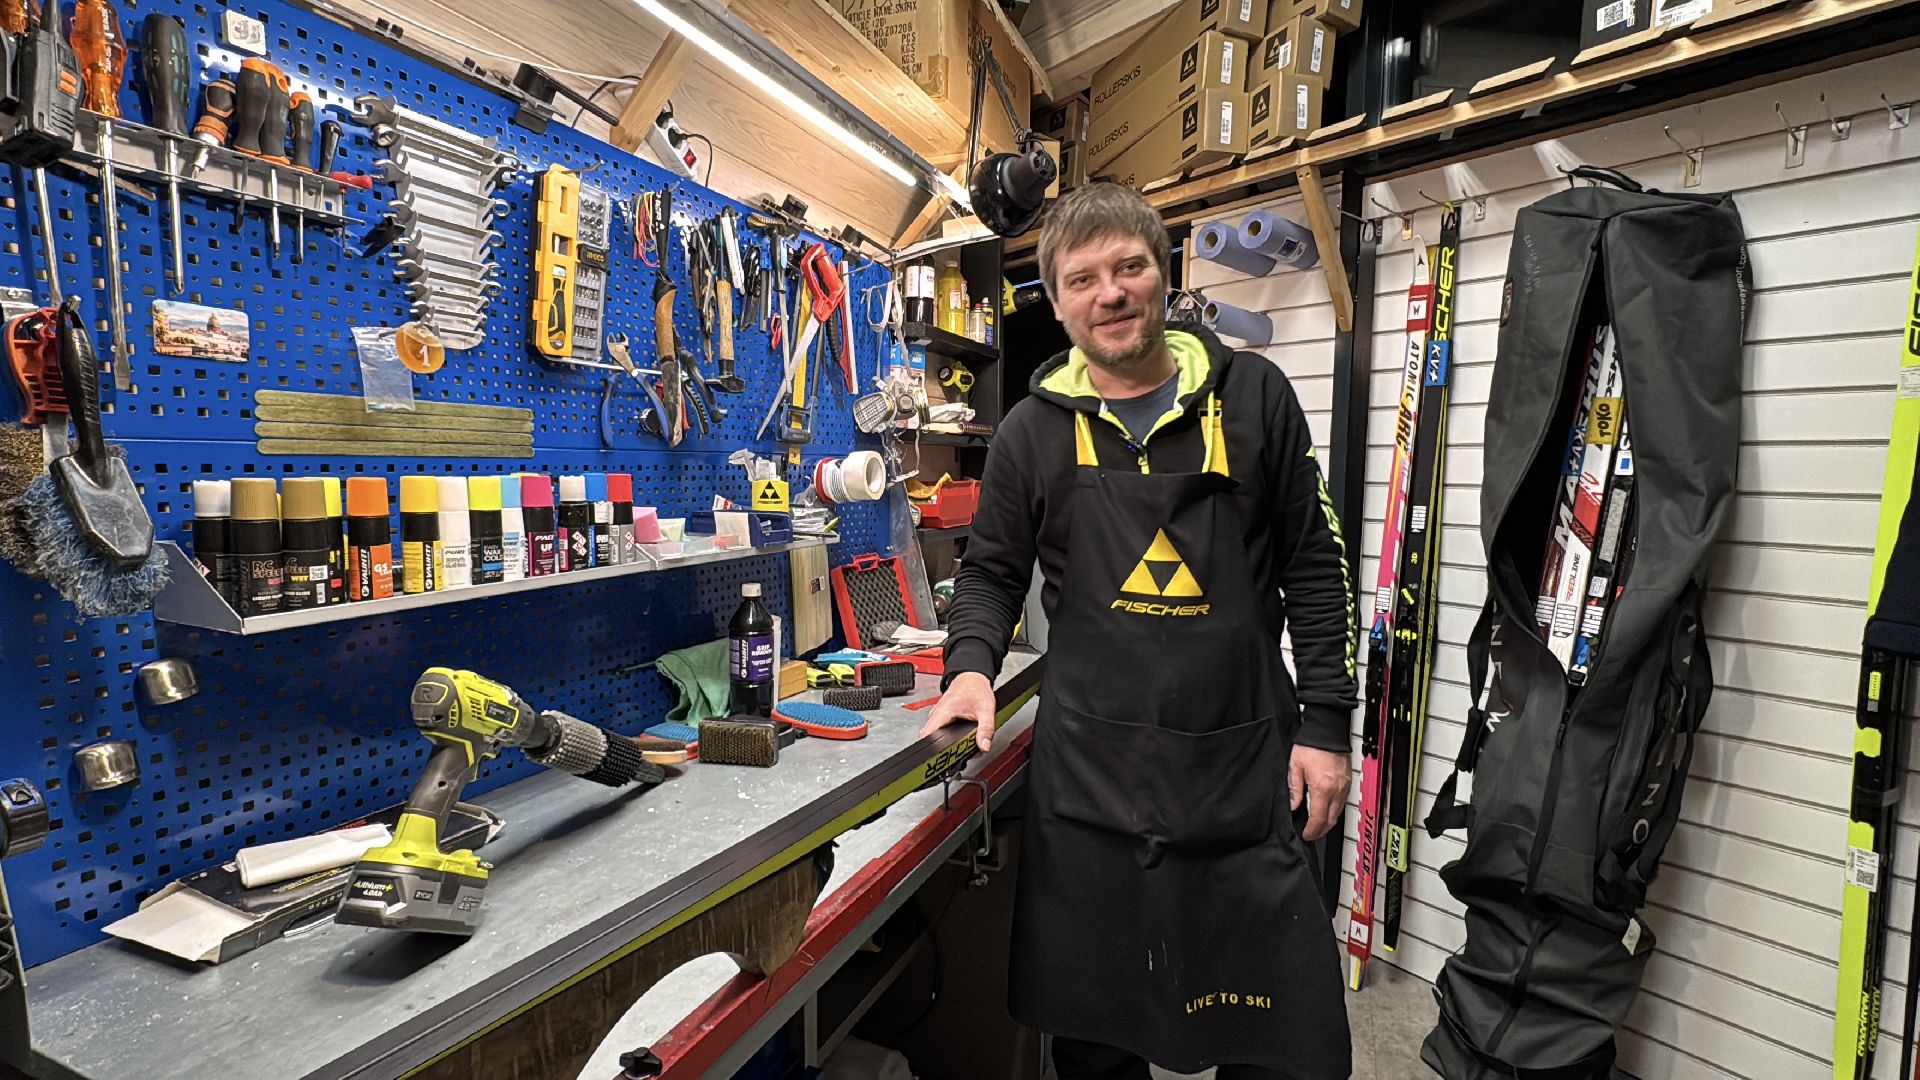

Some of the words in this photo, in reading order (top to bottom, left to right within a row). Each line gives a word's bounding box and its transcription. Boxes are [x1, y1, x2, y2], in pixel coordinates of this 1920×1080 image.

[900, 43, 916, 54] KGS
[901, 32, 916, 43] PCS
[901, 54, 916, 64] KGS
[911, 62, 922, 74] CM
[1094, 65, 1141, 106] ROLLERSKIS
[1088, 121, 1129, 160] ROLLERSKIS
[1433, 246, 1455, 341] SCHER
[419, 344, 432, 367] 1
[1405, 341, 1421, 402] ATOMIC
[1427, 344, 1441, 382] KV+
[1396, 401, 1413, 450] ARC
[1596, 402, 1612, 438] TOKO
[252, 559, 274, 571] RC
[360, 548, 368, 585] VAUHTI
[425, 544, 433, 578] VAUHTI
[1565, 552, 1581, 603] REDLINE
[1110, 599, 1211, 617] FISCHER
[1362, 809, 1376, 876] ATOMIC
[1185, 993, 1214, 1014] LIVE
[1219, 992, 1239, 1005] TO
[1245, 994, 1271, 1009] SKI
